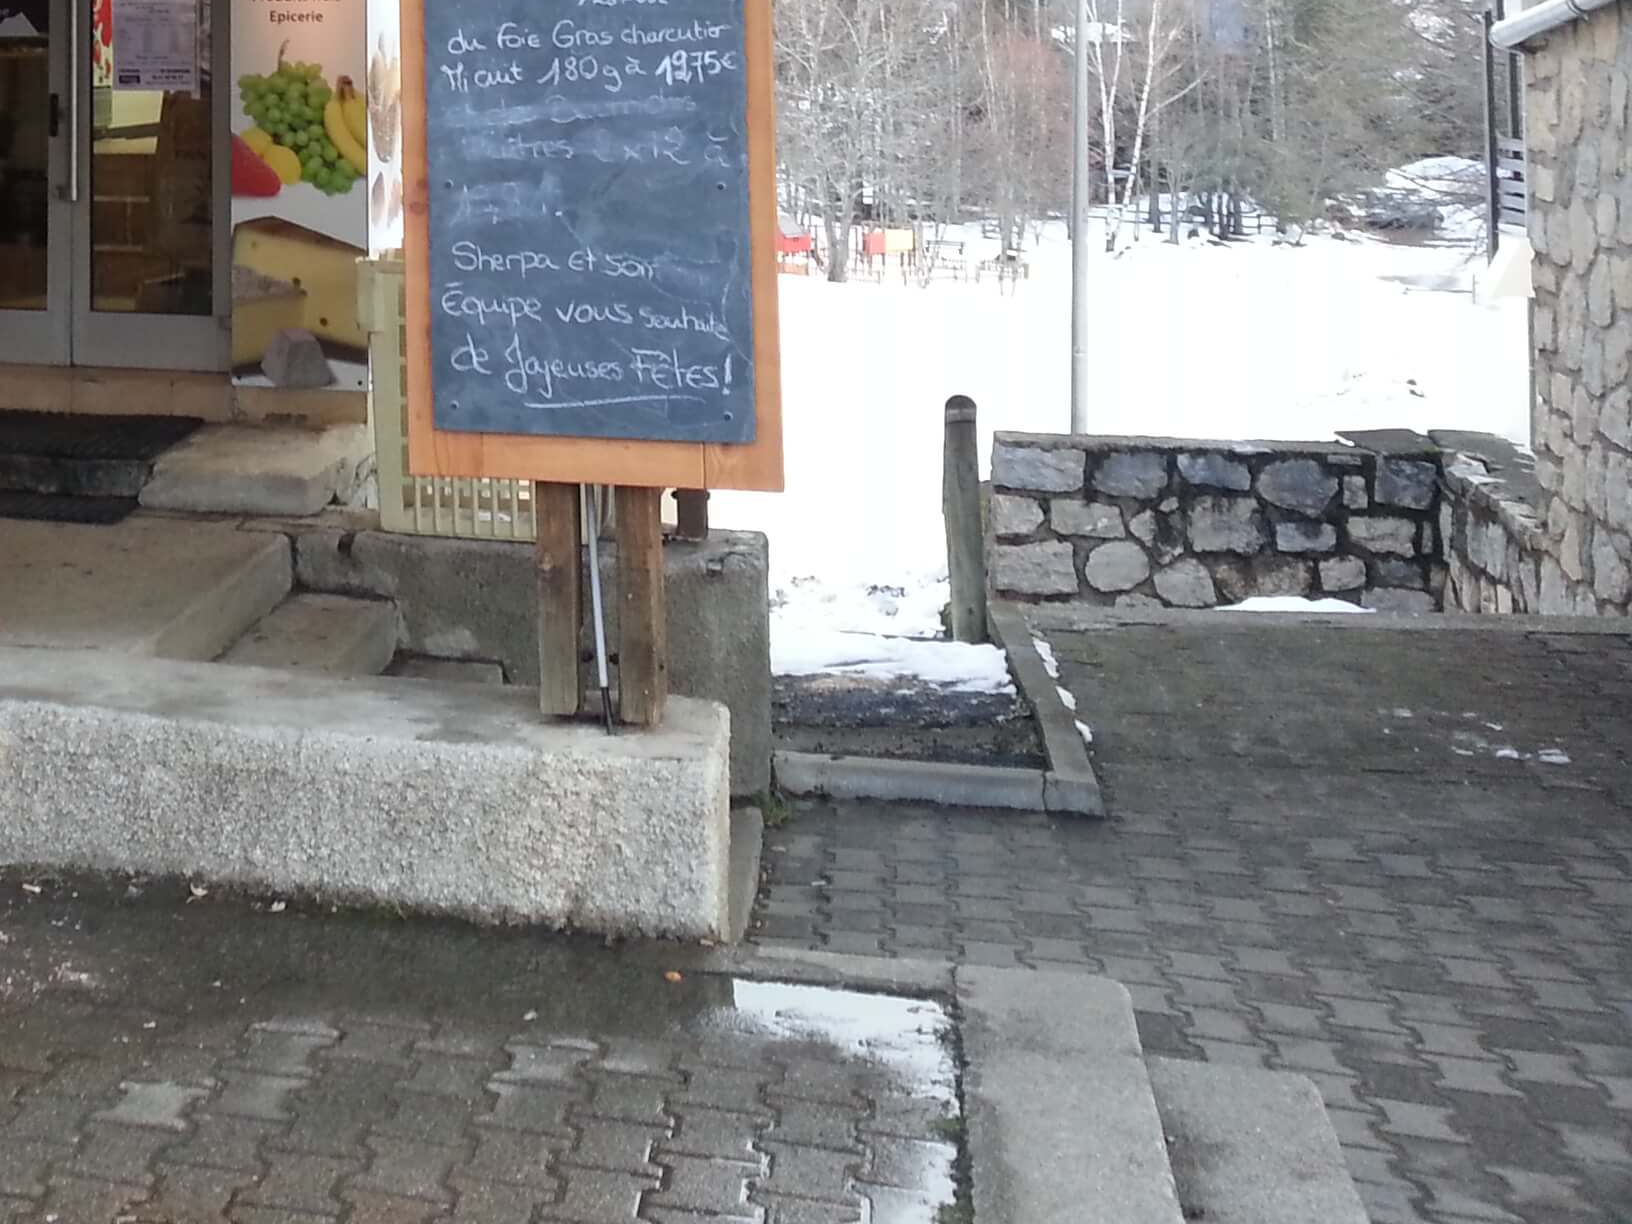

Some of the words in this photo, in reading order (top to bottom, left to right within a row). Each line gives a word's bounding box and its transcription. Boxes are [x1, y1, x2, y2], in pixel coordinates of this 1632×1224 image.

[269, 10, 323, 23] Epicerie
[448, 29, 488, 54] du
[552, 20, 613, 48] Gras
[452, 241, 560, 278] Sherpa
[605, 254, 656, 279] son
[556, 301, 633, 325] vous
